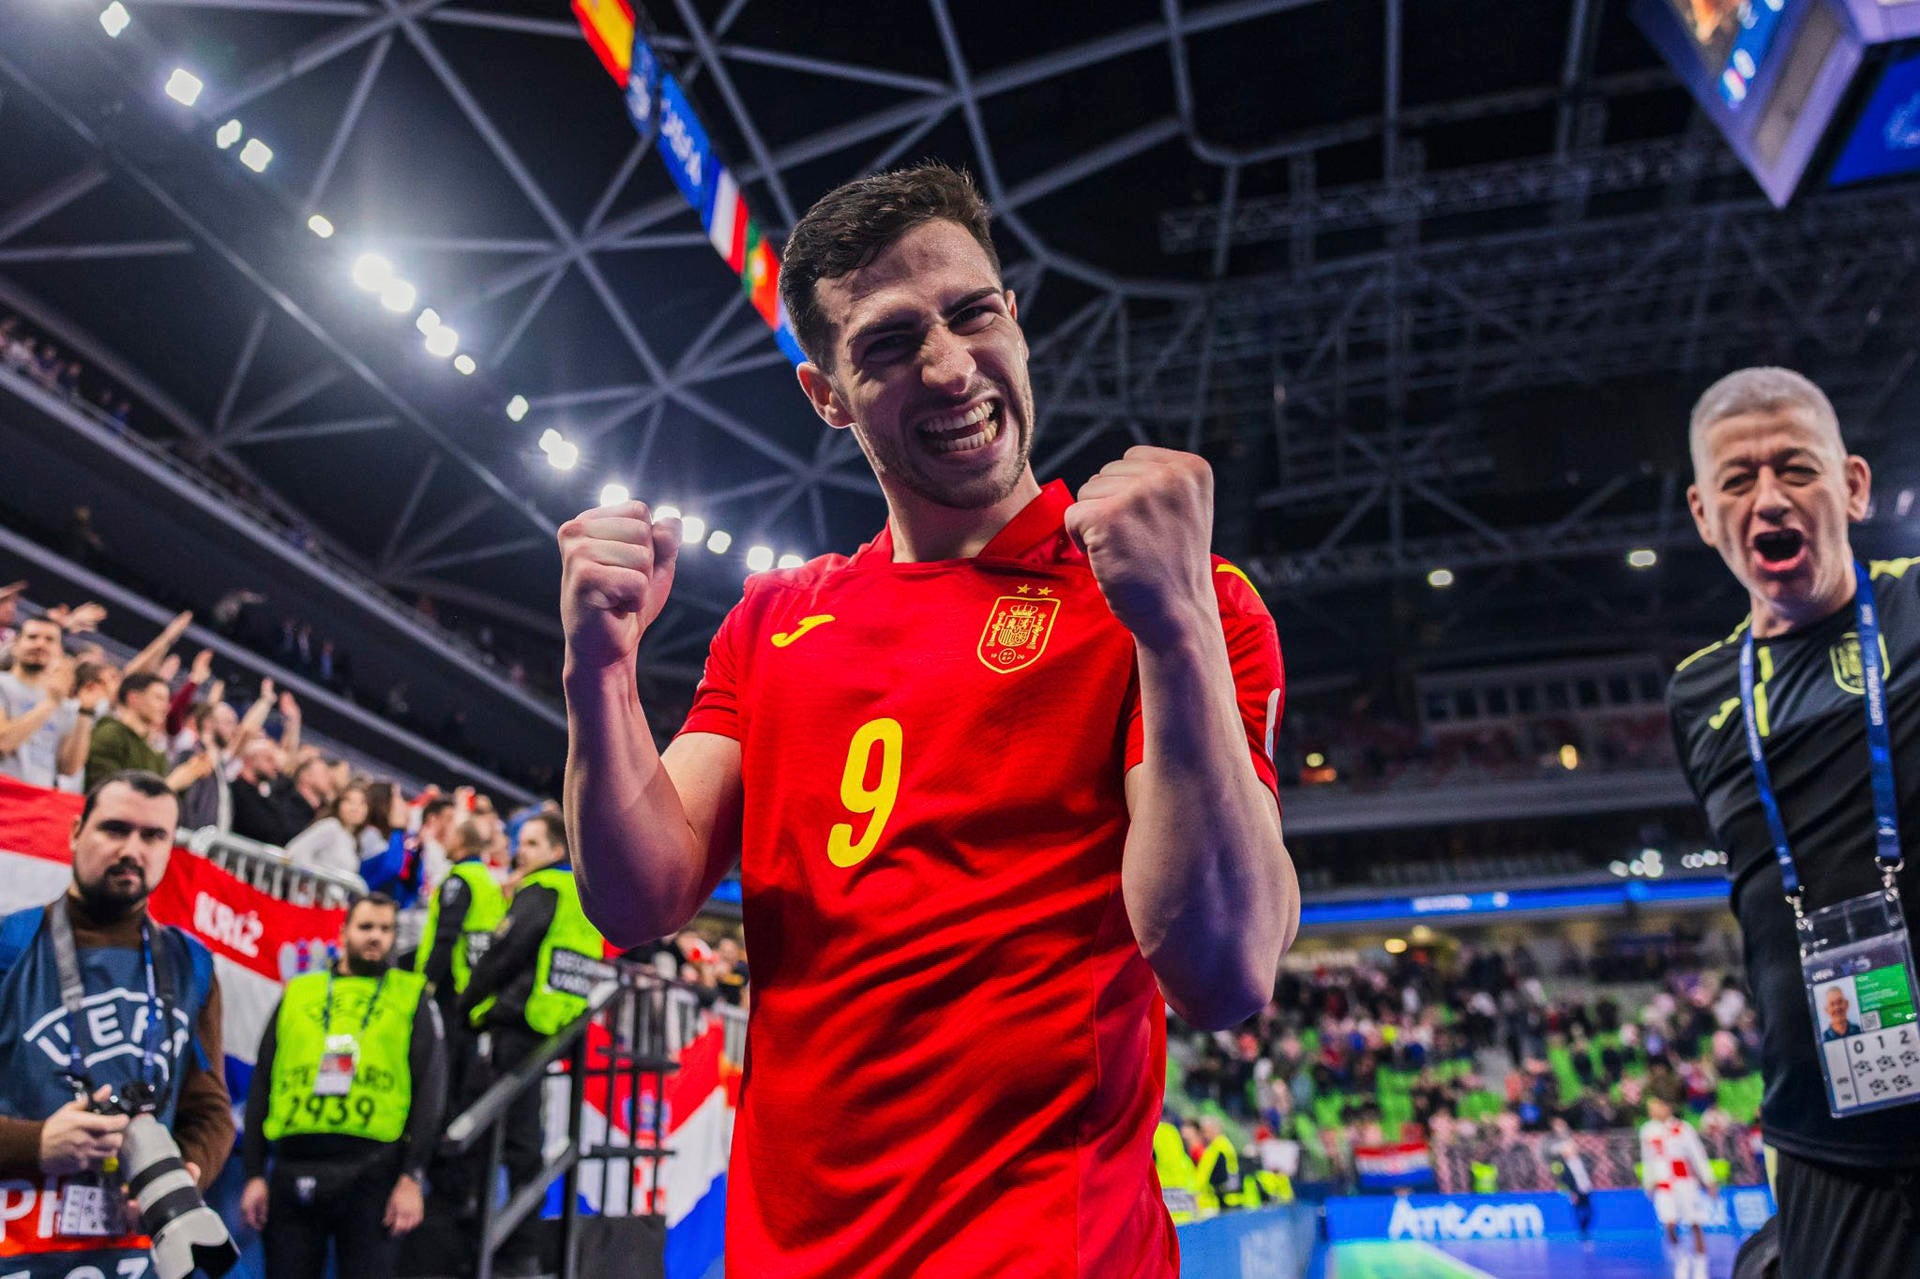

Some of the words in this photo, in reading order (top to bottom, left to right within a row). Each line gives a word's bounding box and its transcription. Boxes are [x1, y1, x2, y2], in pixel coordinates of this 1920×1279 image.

[827, 717, 903, 868] 9
[1853, 1040, 1864, 1054] 0
[1877, 1035, 1885, 1049] 1
[1899, 1030, 1910, 1044] 2
